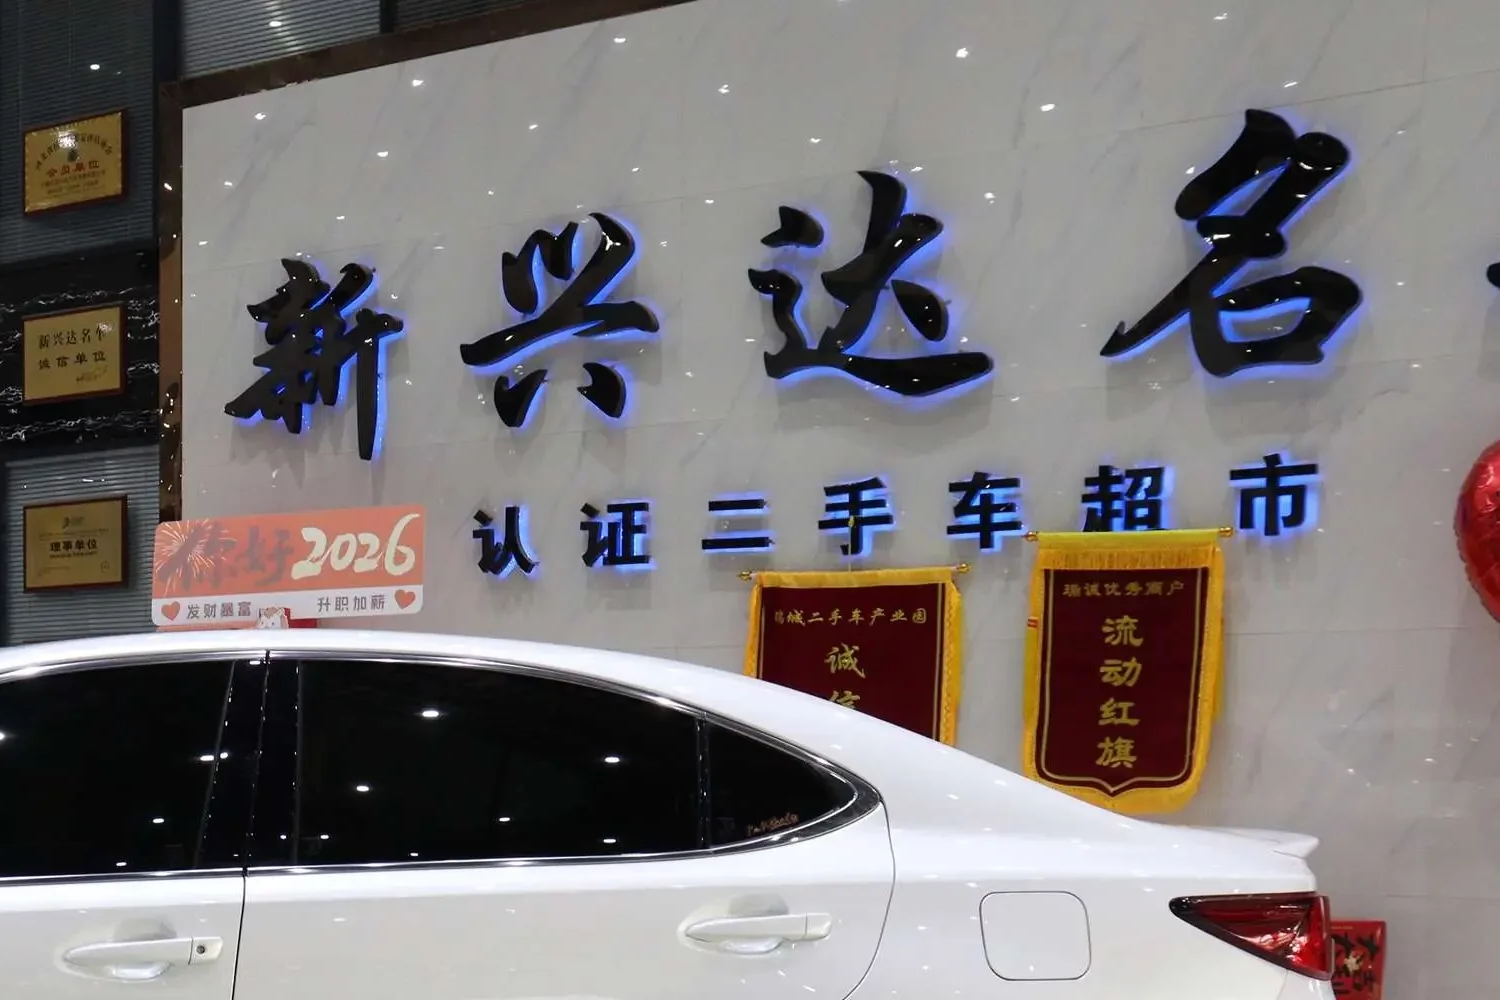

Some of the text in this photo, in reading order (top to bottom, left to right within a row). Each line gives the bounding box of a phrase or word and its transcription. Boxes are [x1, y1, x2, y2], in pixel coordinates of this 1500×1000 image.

[224, 107, 1500, 460] 新兴达名
[38, 350, 107, 370] 诚信单位
[472, 453, 1319, 576] 认证二手车超市
[186, 594, 386, 620] 发财暴富 升职加薪
[1095, 615, 1144, 769] 流动红旗
